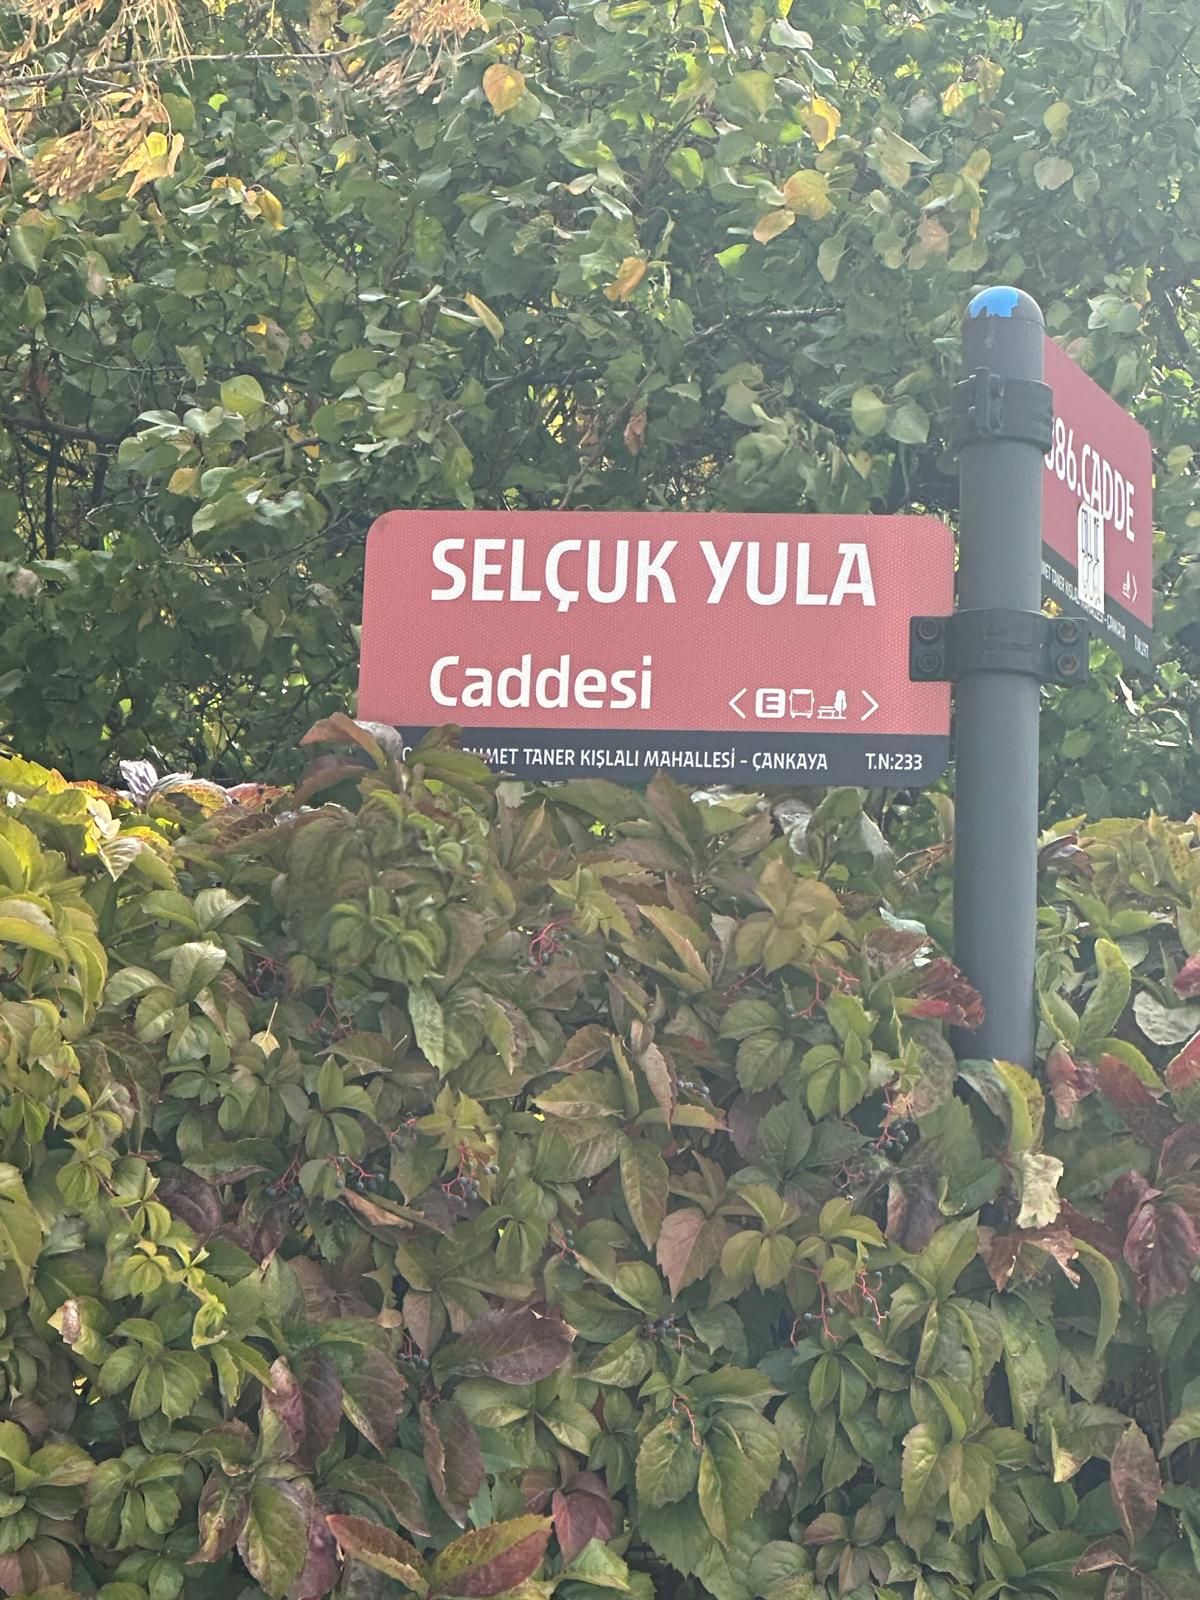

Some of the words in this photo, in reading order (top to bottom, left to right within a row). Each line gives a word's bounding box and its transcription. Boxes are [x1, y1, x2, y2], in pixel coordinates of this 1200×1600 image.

[430, 538, 679, 613] SELÇUK
[698, 541, 877, 607] YULA
[429, 654, 653, 711] Caddesi
[463, 747, 519, 765] MET
[522, 748, 575, 766] TANER
[580, 749, 639, 769] KIŞLALI
[643, 747, 736, 769] MAHALLESİ
[752, 752, 828, 772] ÇANKAYA
[865, 752, 923, 771] T.N:233
